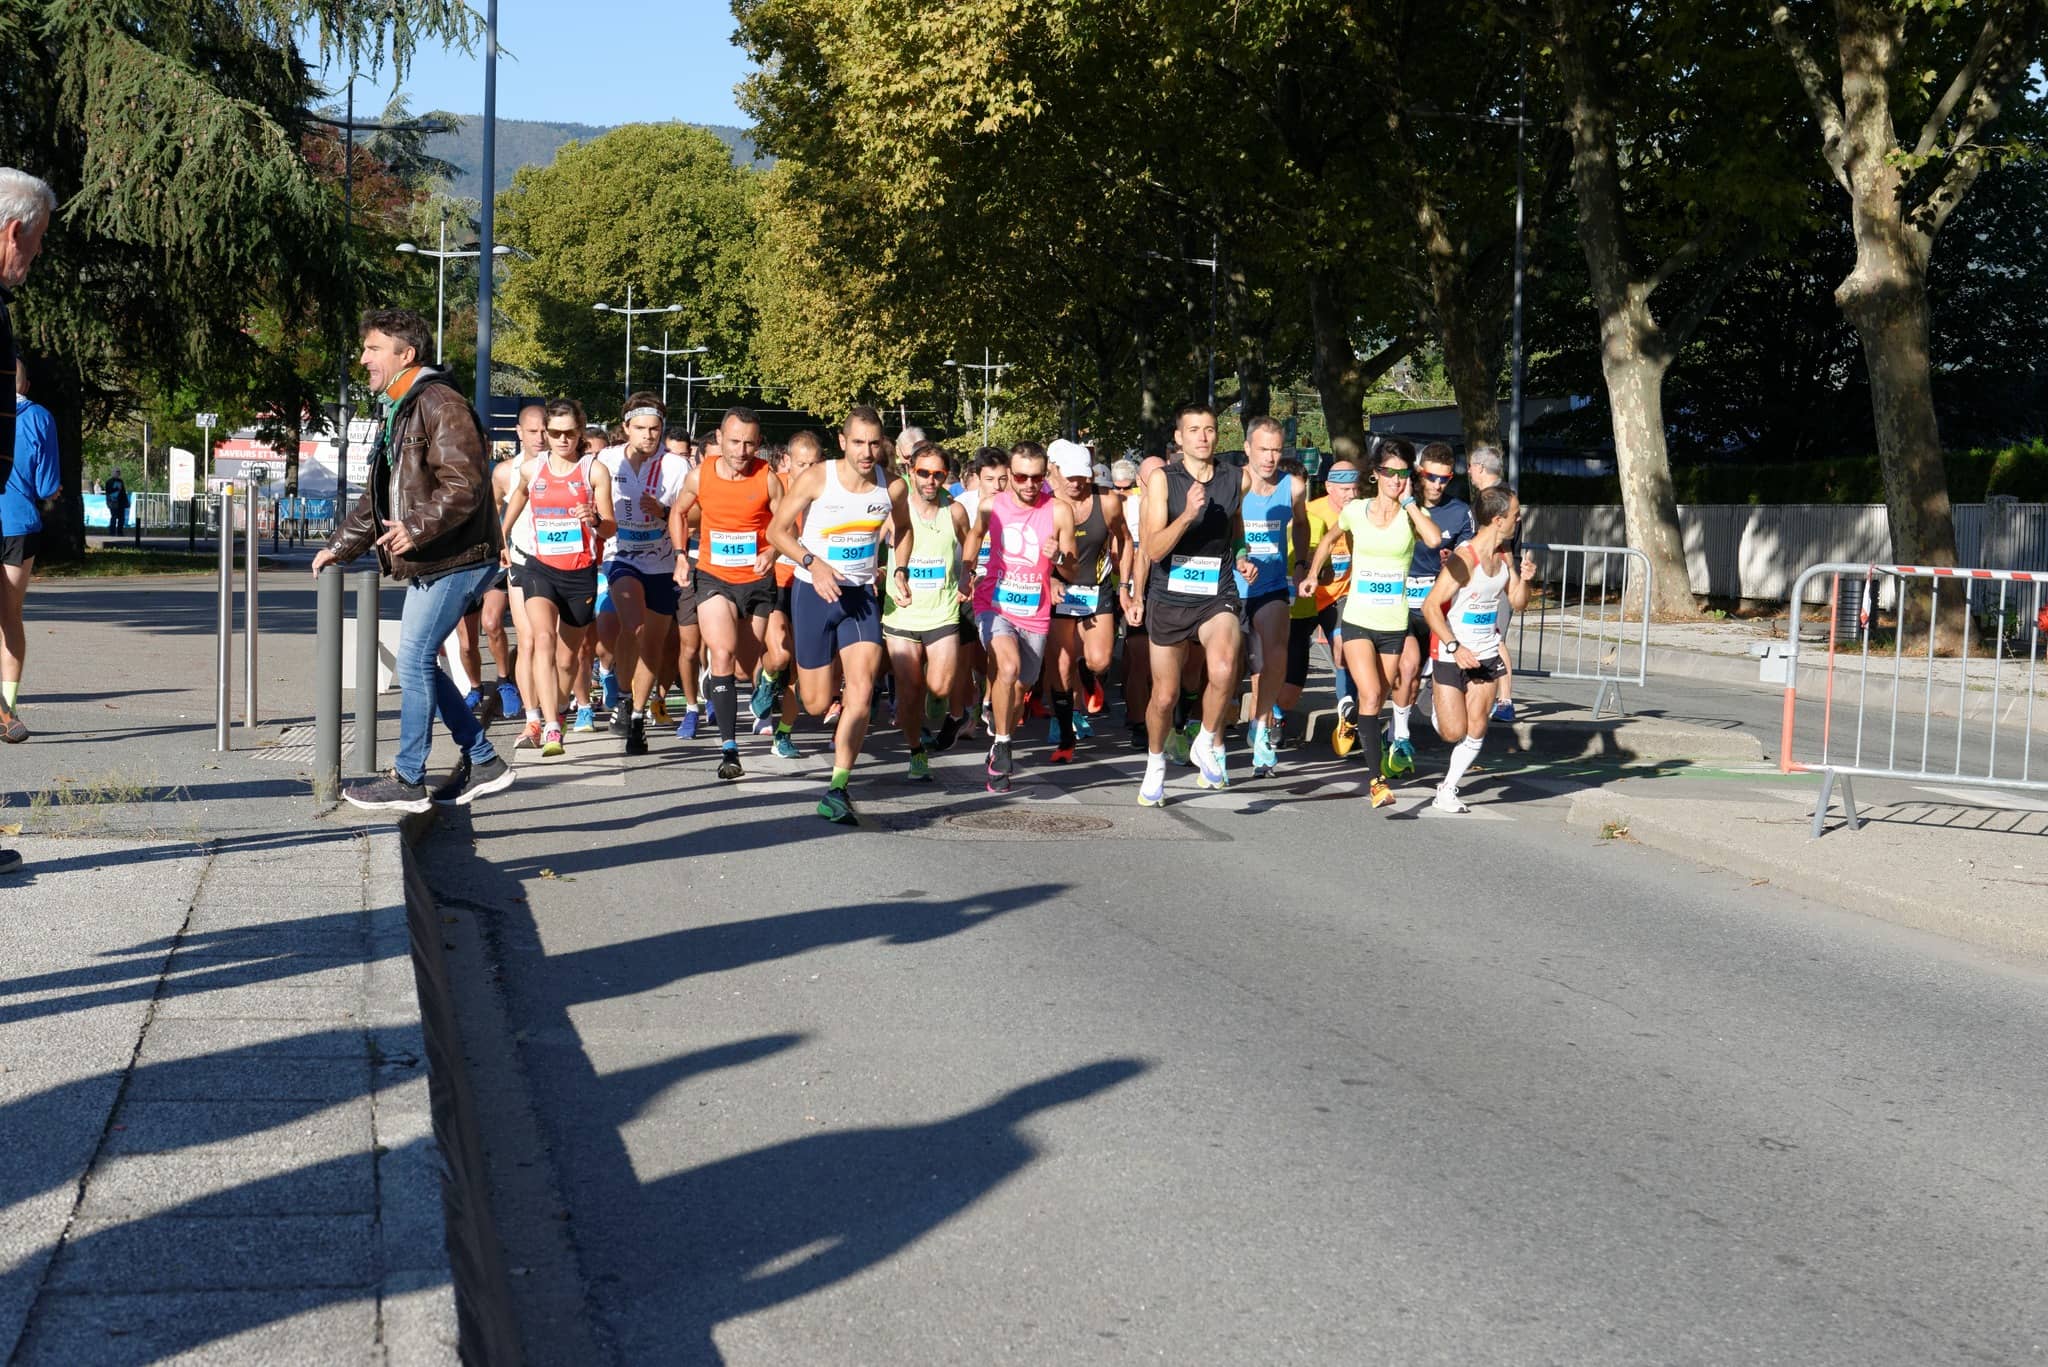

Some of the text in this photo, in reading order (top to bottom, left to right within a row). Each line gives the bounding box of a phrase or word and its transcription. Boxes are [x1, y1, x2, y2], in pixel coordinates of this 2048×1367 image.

[219, 449, 256, 458] SAVEURS
[547, 531, 569, 542] 427
[1247, 532, 1269, 542] 362
[722, 544, 744, 555] 415
[842, 547, 864, 559] 397
[913, 568, 933, 578] 311
[1183, 568, 1206, 581] 321
[1370, 582, 1392, 593] 393
[1406, 587, 1424, 597] 327
[1006, 592, 1028, 604] 304
[1474, 614, 1491, 624] 354
